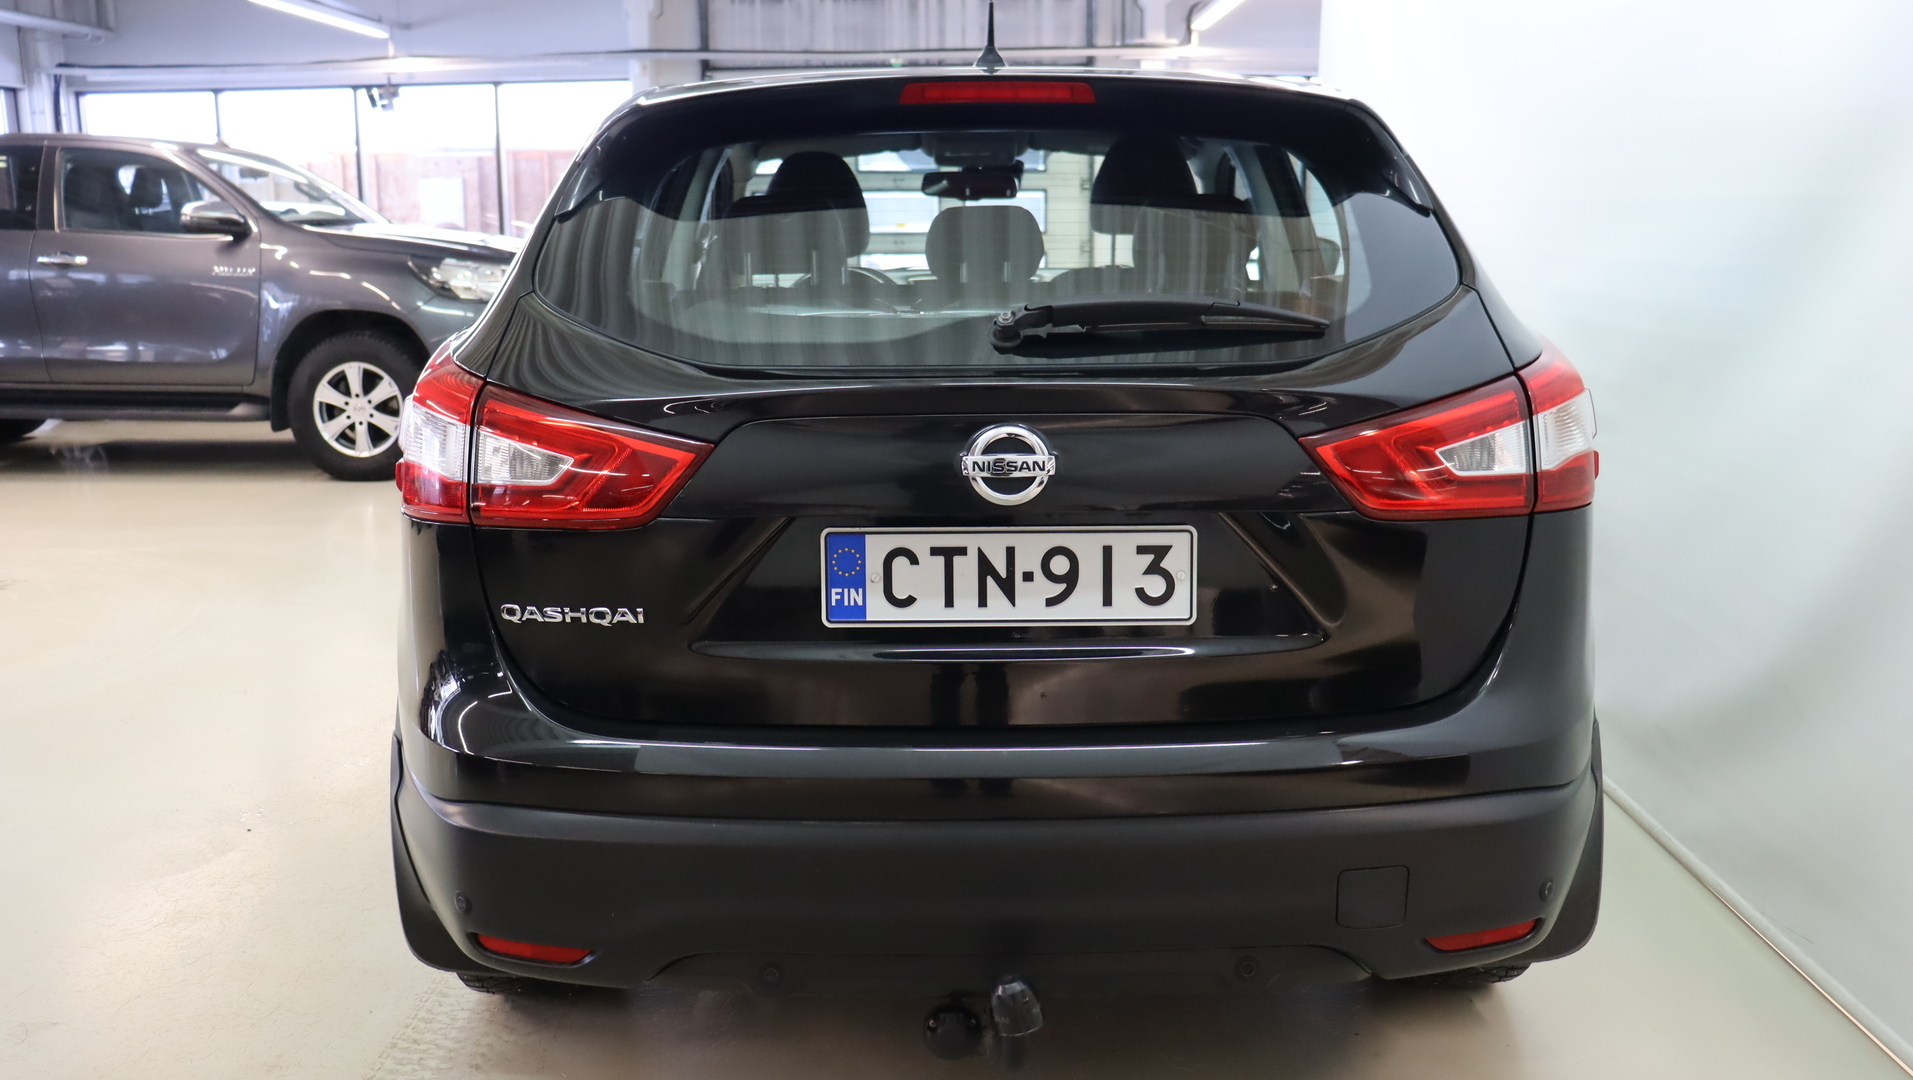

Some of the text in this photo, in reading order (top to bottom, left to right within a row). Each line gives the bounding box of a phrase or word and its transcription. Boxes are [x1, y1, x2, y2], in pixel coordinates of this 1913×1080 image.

[972, 460, 1046, 473] NISSAN
[882, 545, 1176, 609] CTN-913
[831, 588, 863, 607] FIN
[500, 604, 645, 627] QASHQAI
